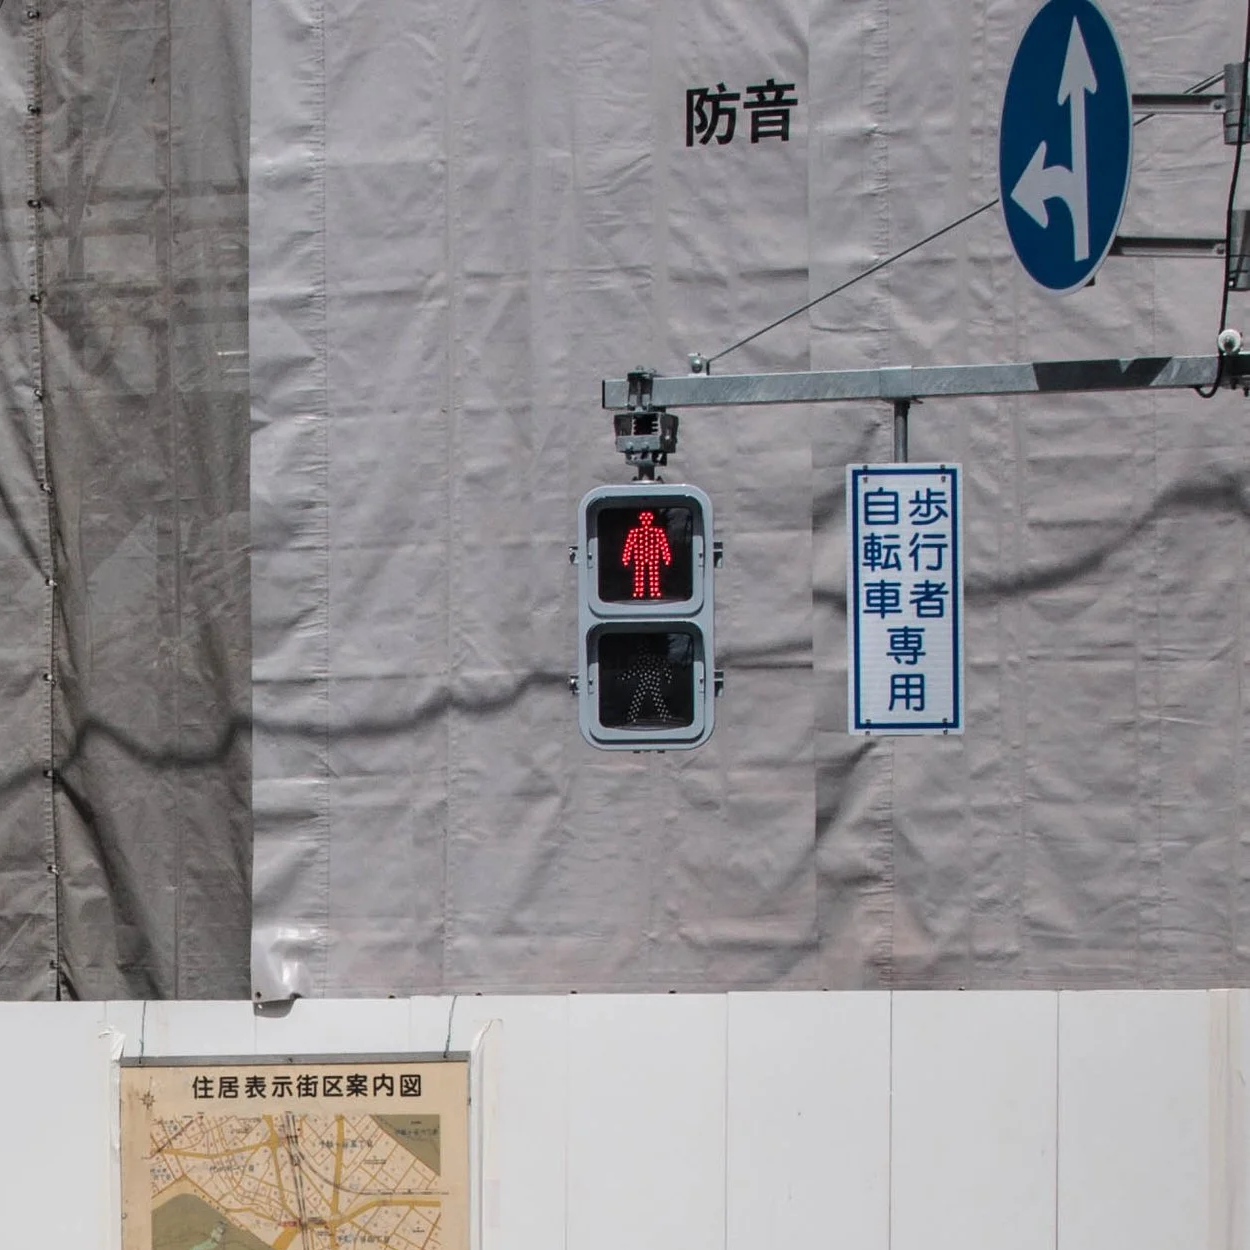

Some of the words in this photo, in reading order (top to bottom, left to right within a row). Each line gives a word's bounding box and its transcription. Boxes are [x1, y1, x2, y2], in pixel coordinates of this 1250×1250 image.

[685, 78, 799, 148] 防音
[862, 486, 903, 620] 自転車
[908, 487, 950, 619] 歩行者
[886, 625, 927, 712] 専用
[191, 1073, 422, 1099] 住居表示街区案内図
